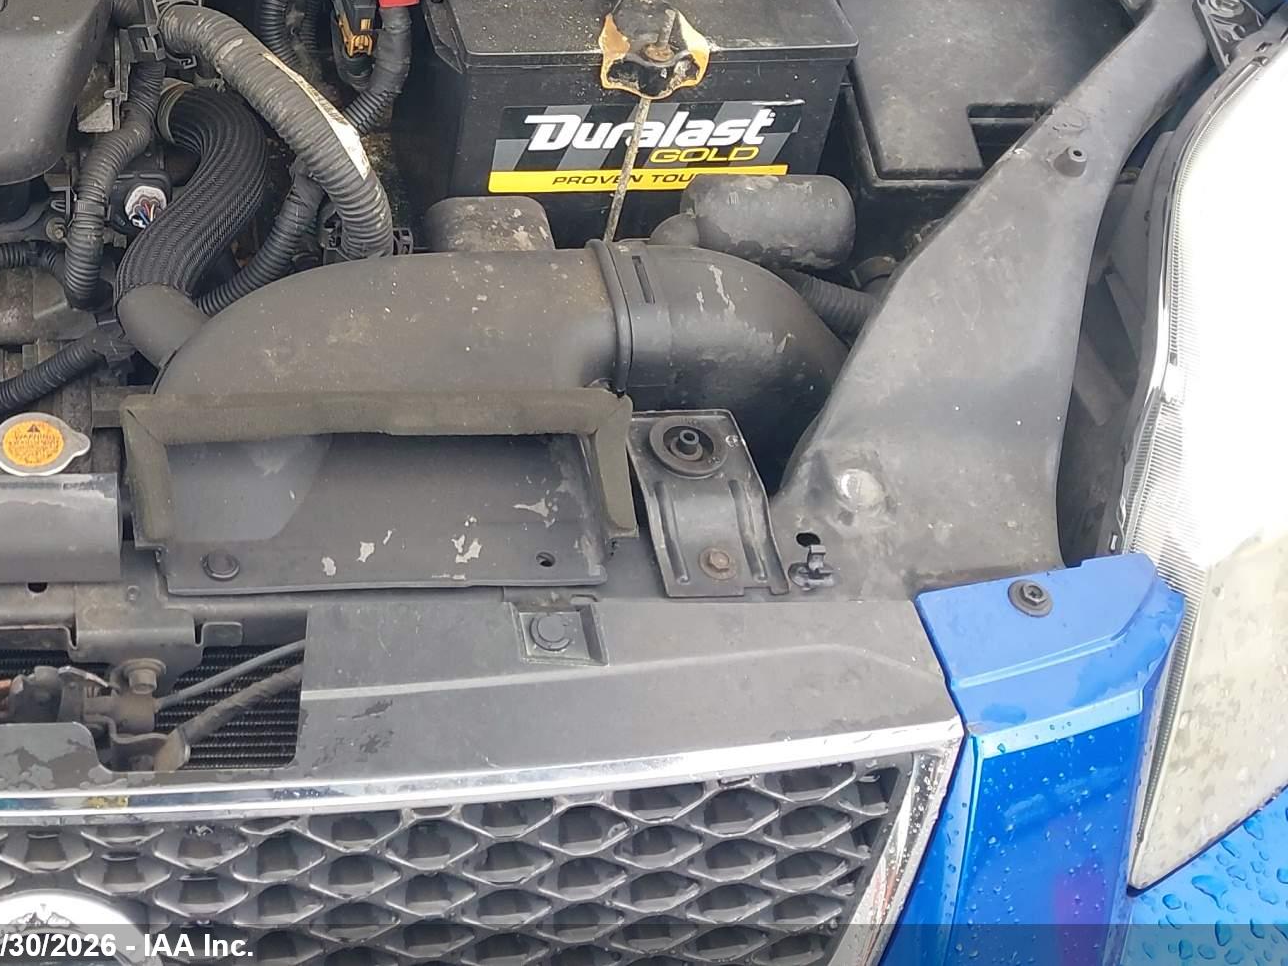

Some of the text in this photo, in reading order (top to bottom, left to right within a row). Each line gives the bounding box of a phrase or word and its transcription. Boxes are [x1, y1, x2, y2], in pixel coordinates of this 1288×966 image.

[523, 108, 775, 151] Duralast
[649, 146, 760, 164] GOLD
[551, 173, 696, 186] PROVEN TOU
